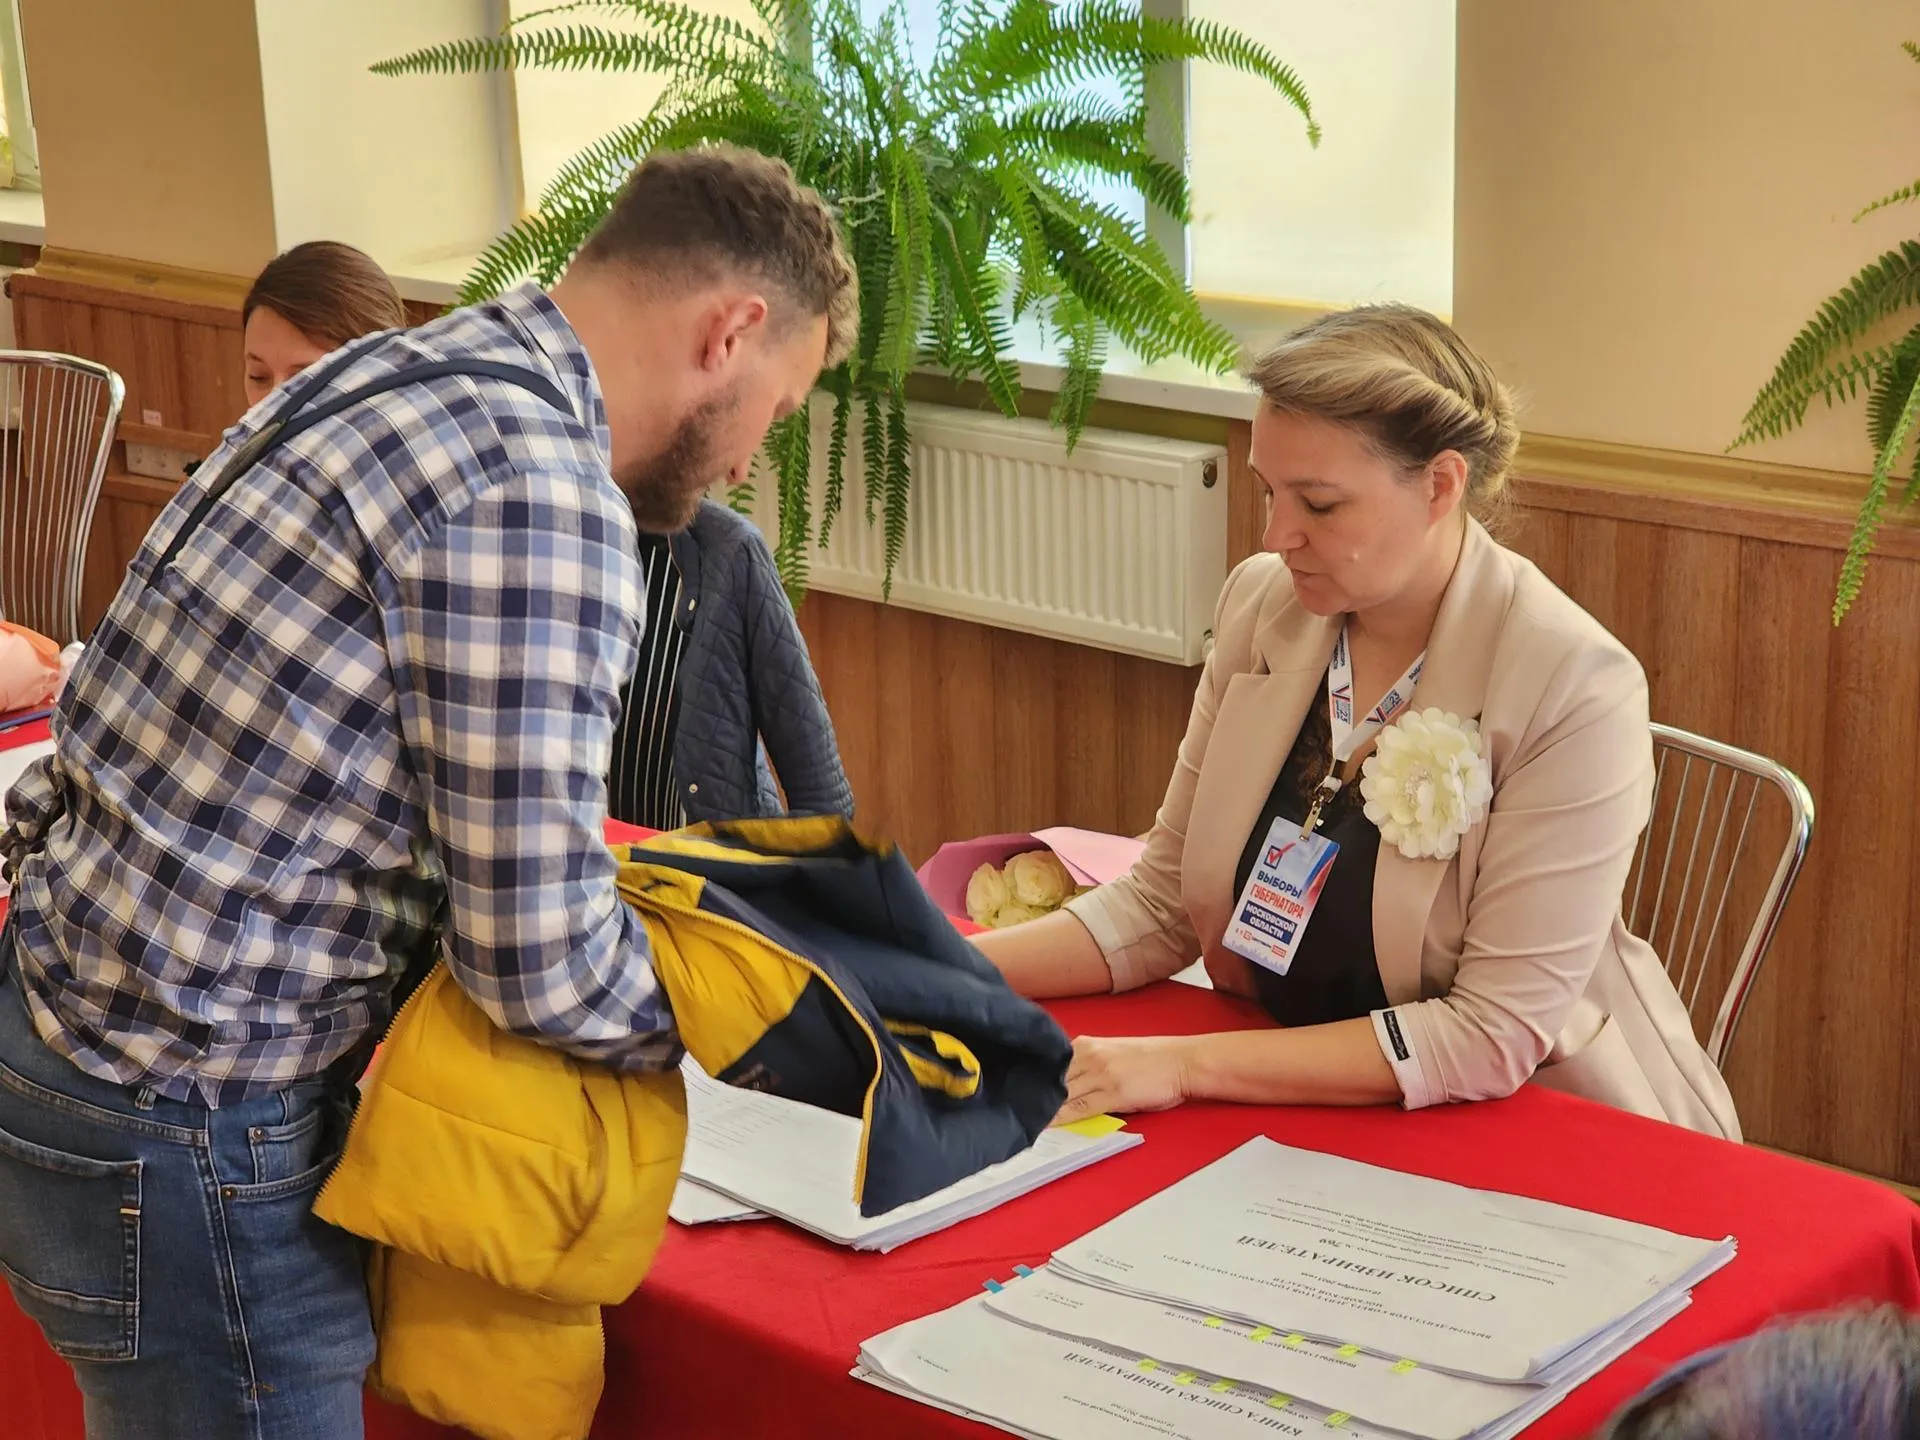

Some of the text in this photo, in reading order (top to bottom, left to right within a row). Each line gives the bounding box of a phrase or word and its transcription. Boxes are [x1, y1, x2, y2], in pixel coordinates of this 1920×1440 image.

[1257, 871, 1302, 900] ВЫБОРЫ
[1250, 883, 1304, 919] ГУБЕРНАТОРА
[1246, 903, 1298, 934] МОСКОВСКОЙ
[1249, 918, 1284, 940] ОБЛАСТИ
[1231, 1234, 1397, 1280] ИЗБИРАТЕЛЕЙ
[1393, 1273, 1499, 1302] СПИСОК
[1060, 1351, 1177, 1395] ИЗБИРАТЕЛЕЙ
[1173, 1390, 1246, 1415] СПИСКА
[1241, 1410, 1304, 1437] КНИГА
